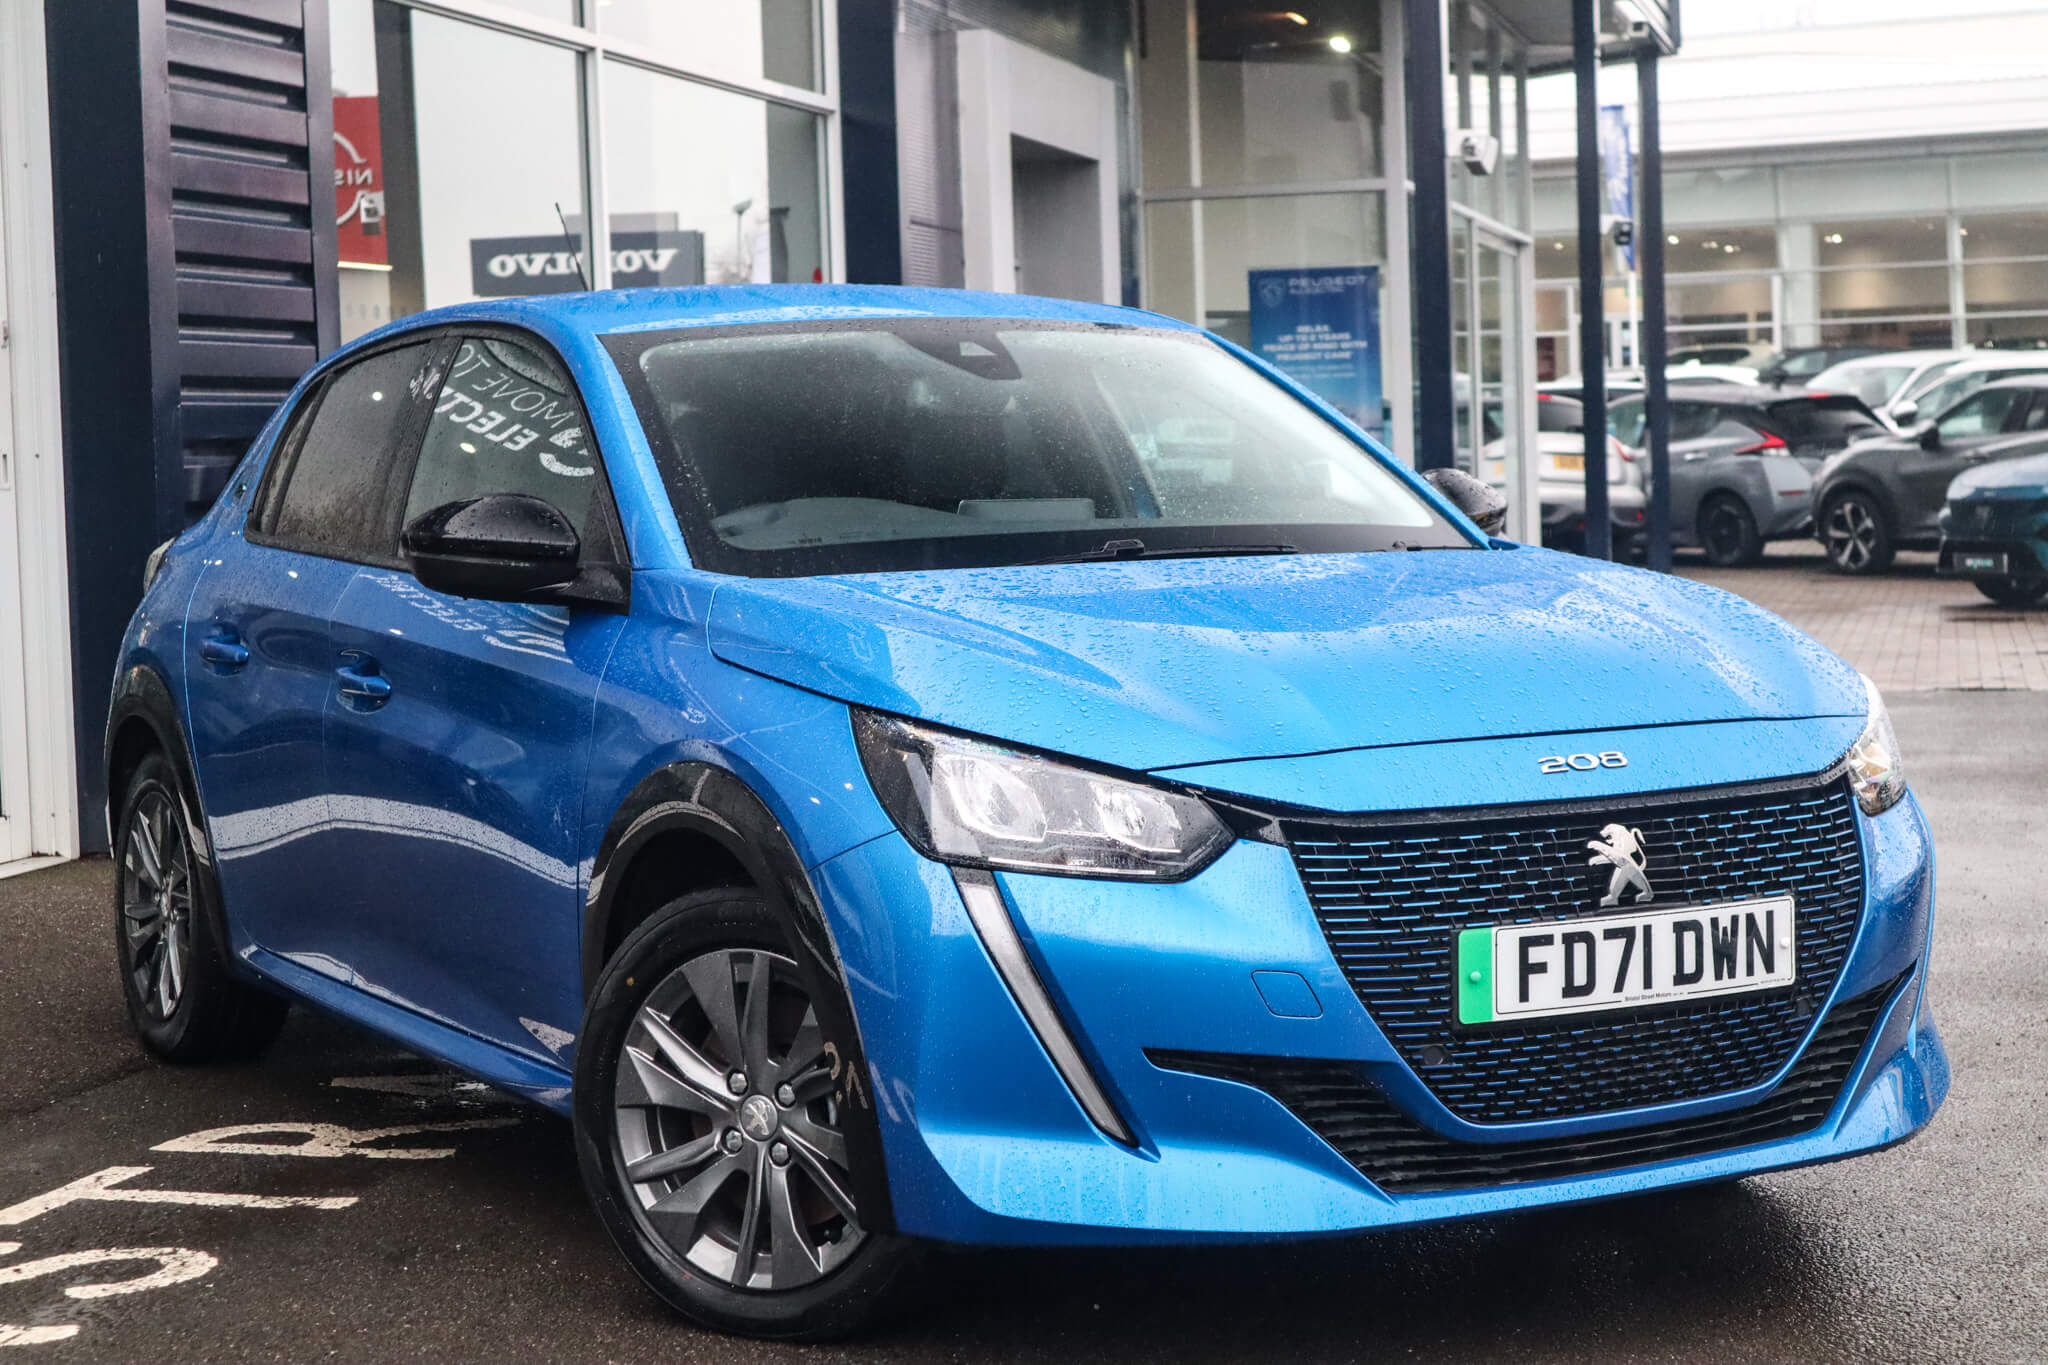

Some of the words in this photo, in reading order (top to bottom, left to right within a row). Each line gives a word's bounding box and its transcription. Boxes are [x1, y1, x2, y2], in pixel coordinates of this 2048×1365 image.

[1537, 750, 1629, 775] 208
[1517, 923, 1653, 1003] FD71
[1672, 909, 1776, 987] DWN
